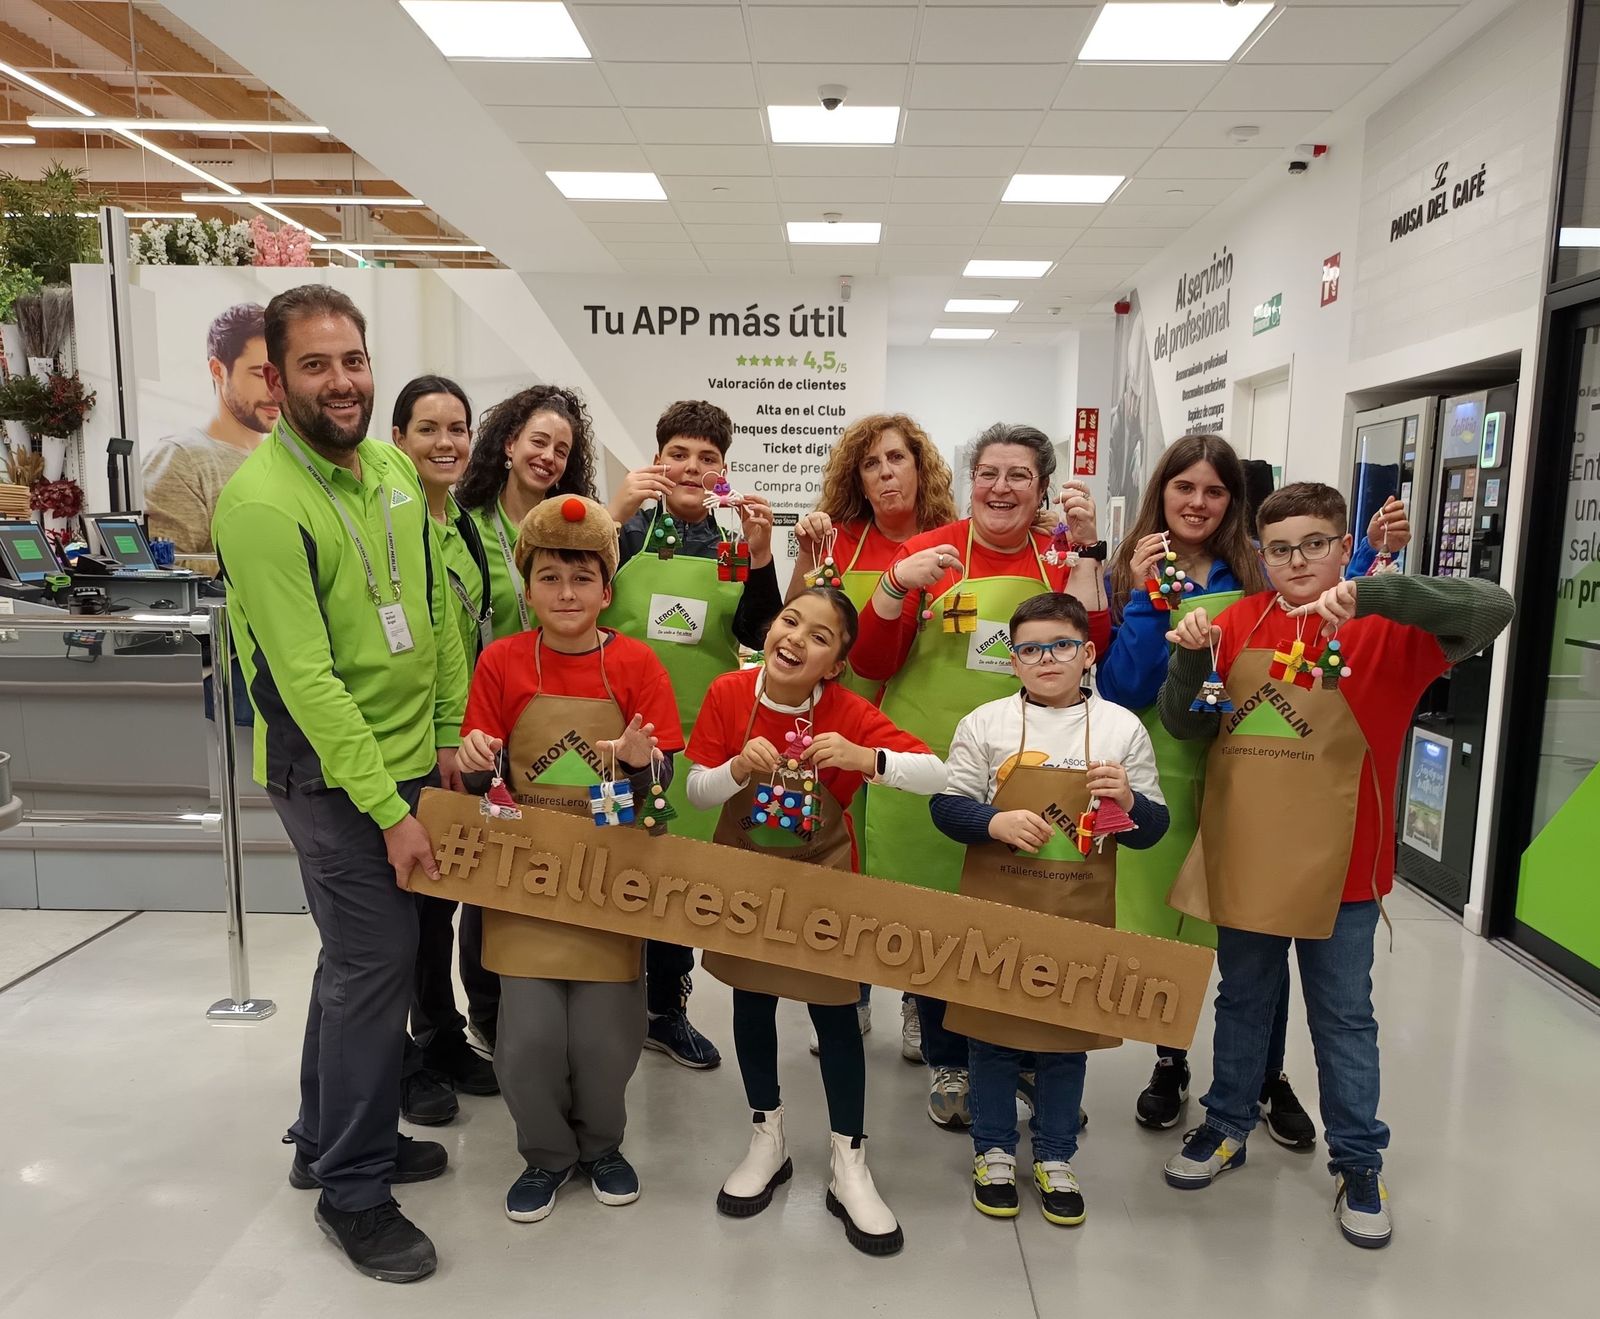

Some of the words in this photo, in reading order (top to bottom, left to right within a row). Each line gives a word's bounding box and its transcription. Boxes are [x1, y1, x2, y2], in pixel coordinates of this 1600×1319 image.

[1390, 204, 1423, 243] PAUSA
[1426, 191, 1448, 223] DEL
[1452, 163, 1486, 209] CAFÉ
[1176, 273, 1187, 312] Al
[1187, 245, 1233, 305] servicio
[583, 305, 624, 335] Tu
[632, 305, 700, 336] APP
[709, 303, 780, 337] más
[789, 303, 848, 338] útil
[1154, 322, 1168, 361] del
[1169, 288, 1230, 363] profesional
[708, 377, 775, 390] Valoración
[778, 378, 793, 390] de
[796, 378, 847, 391] clientes
[756, 404, 781, 415] Alta
[785, 407, 799, 415] en
[803, 405, 814, 416] el
[818, 405, 846, 416] Club
[733, 423, 777, 436] heques
[763, 443, 802, 454] Ticket
[731, 461, 779, 472] Escaner
[782, 461, 797, 473] de
[801, 464, 826, 476] prec
[754, 481, 801, 494] Compra
[1575, 499, 1600, 521] un
[654, 606, 676, 625] LEROY
[674, 603, 698, 631] MERLIN
[975, 633, 1000, 654] LEROY
[1226, 691, 1263, 735] LEROY
[1260, 682, 1313, 738] MERLIN
[525, 739, 568, 782] LEROY
[1000, 865, 1094, 882] #TalleresLeroyMerlin
[435, 822, 1181, 1024] #TalleresLeroyMerlin
